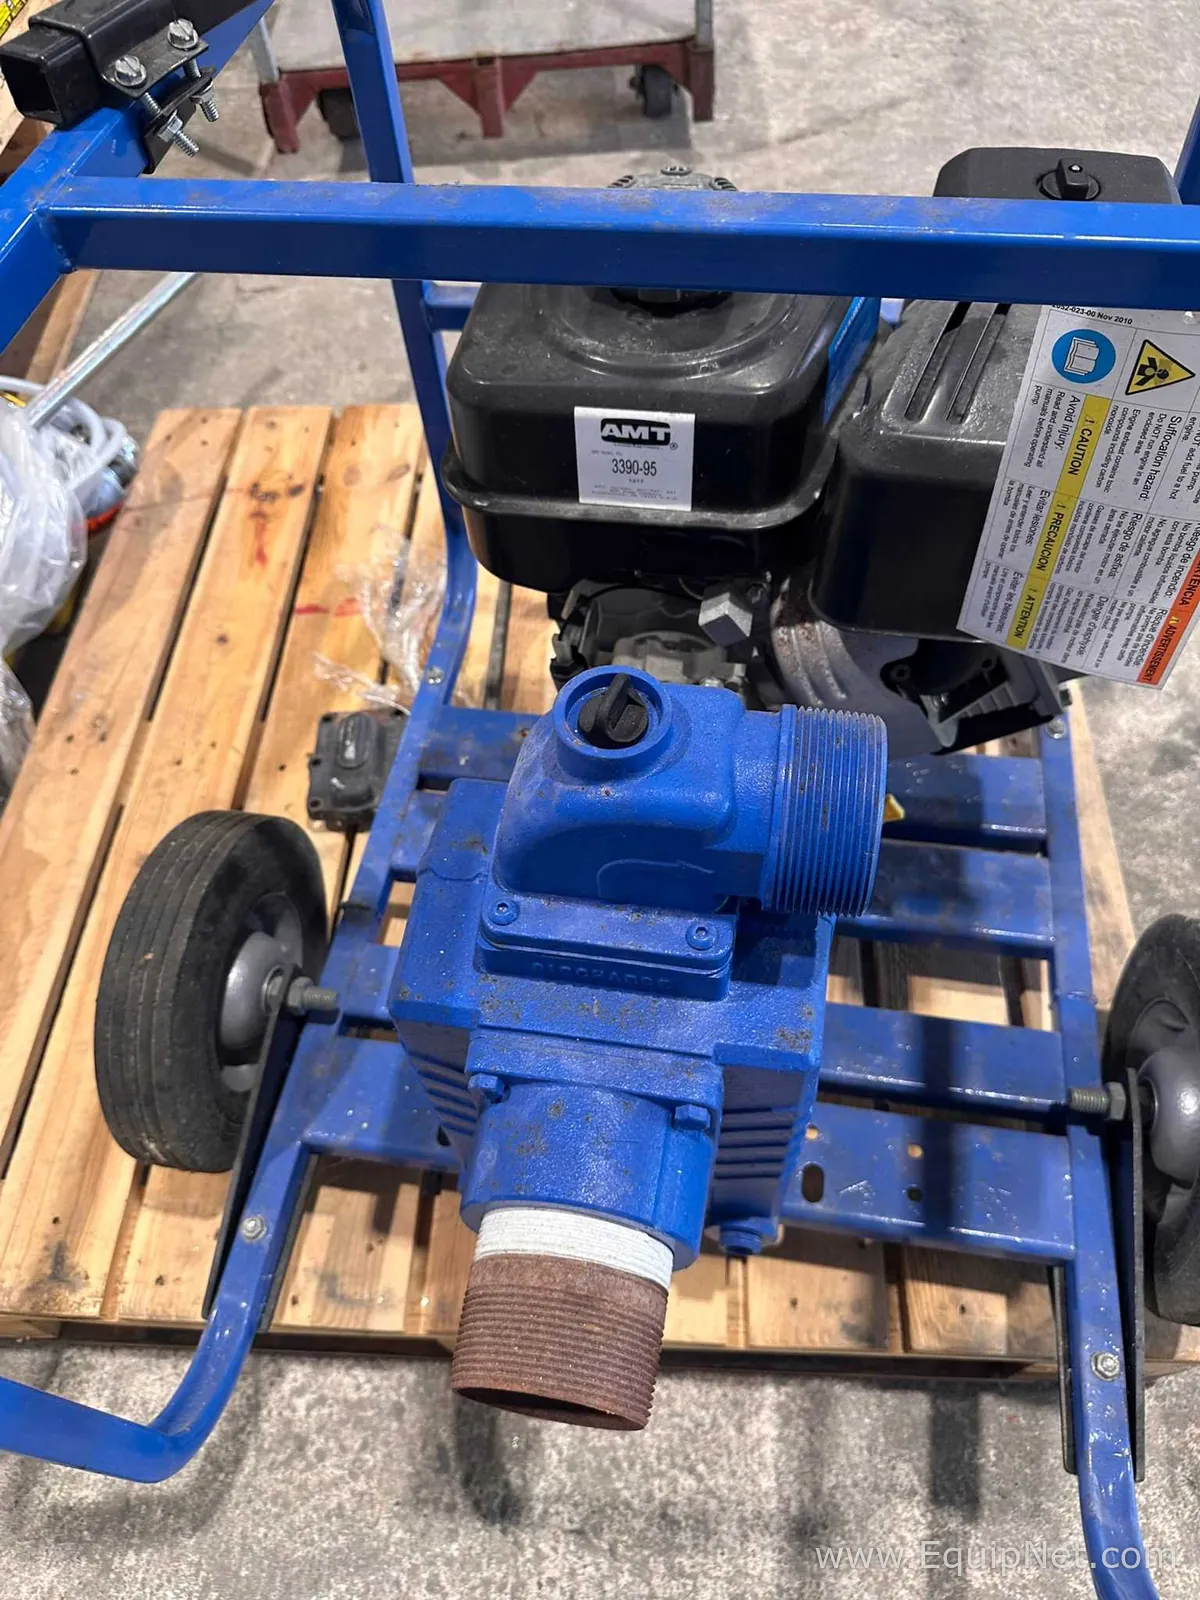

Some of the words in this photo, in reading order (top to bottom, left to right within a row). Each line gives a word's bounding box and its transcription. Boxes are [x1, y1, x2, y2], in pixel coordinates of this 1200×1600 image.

[1097, 312, 1112, 320] Nov
[1114, 316, 1133, 325] 2010
[1039, 388, 1053, 416] manuals
[1052, 391, 1065, 409] Read
[1064, 395, 1080, 422] Avoid
[1033, 417, 1045, 438] before
[1048, 411, 1058, 423] and
[1111, 407, 1129, 441] compounds
[1126, 408, 1141, 430] Engine
[1139, 411, 1155, 439] enclosed
[1156, 413, 1167, 423] Do
[601, 421, 671, 443] AMT
[1054, 423, 1072, 450] injury:
[1151, 423, 1162, 438] NOT
[1180, 416, 1197, 442] engine.
[1038, 424, 1053, 459] understand
[1067, 428, 1092, 475] CAUTION
[1117, 431, 1131, 454] exhaust
[1146, 439, 1154, 449] run
[1152, 415, 1182, 467] Suffocation
[1023, 438, 1038, 467] operating
[1100, 442, 1117, 468] including
[1138, 450, 1150, 470] engine
[1185, 447, 1196, 461] add
[612, 458, 657, 476] 3390-95
[1108, 455, 1122, 478] contains
[1180, 462, 1191, 474] fuel
[1095, 468, 1106, 488] carbon
[1103, 479, 1113, 493] toxic
[1138, 468, 1160, 501] hazard:
[1035, 489, 1050, 513] Evitar
[1168, 488, 1179, 499] hot
[1118, 510, 1128, 520] No
[1122, 512, 1142, 540] Riesgo
[1143, 516, 1154, 534] motor
[1156, 518, 1166, 528] No
[1170, 520, 1180, 532] con
[1181, 522, 1191, 532] No
[1036, 512, 1064, 571] PRECAUCION
[1118, 541, 1129, 552] de
[1146, 528, 1161, 551] agregue
[1163, 532, 1174, 545] esta
[1172, 532, 1186, 552] bomba
[1179, 552, 1191, 564] de
[1163, 564, 1187, 598] incendio:
[1014, 594, 1035, 638] ATTENTION
[1091, 595, 1108, 621] Danger
[1148, 608, 1167, 633] Risque
[1142, 624, 1176, 681] ADVERTISSEMENT
